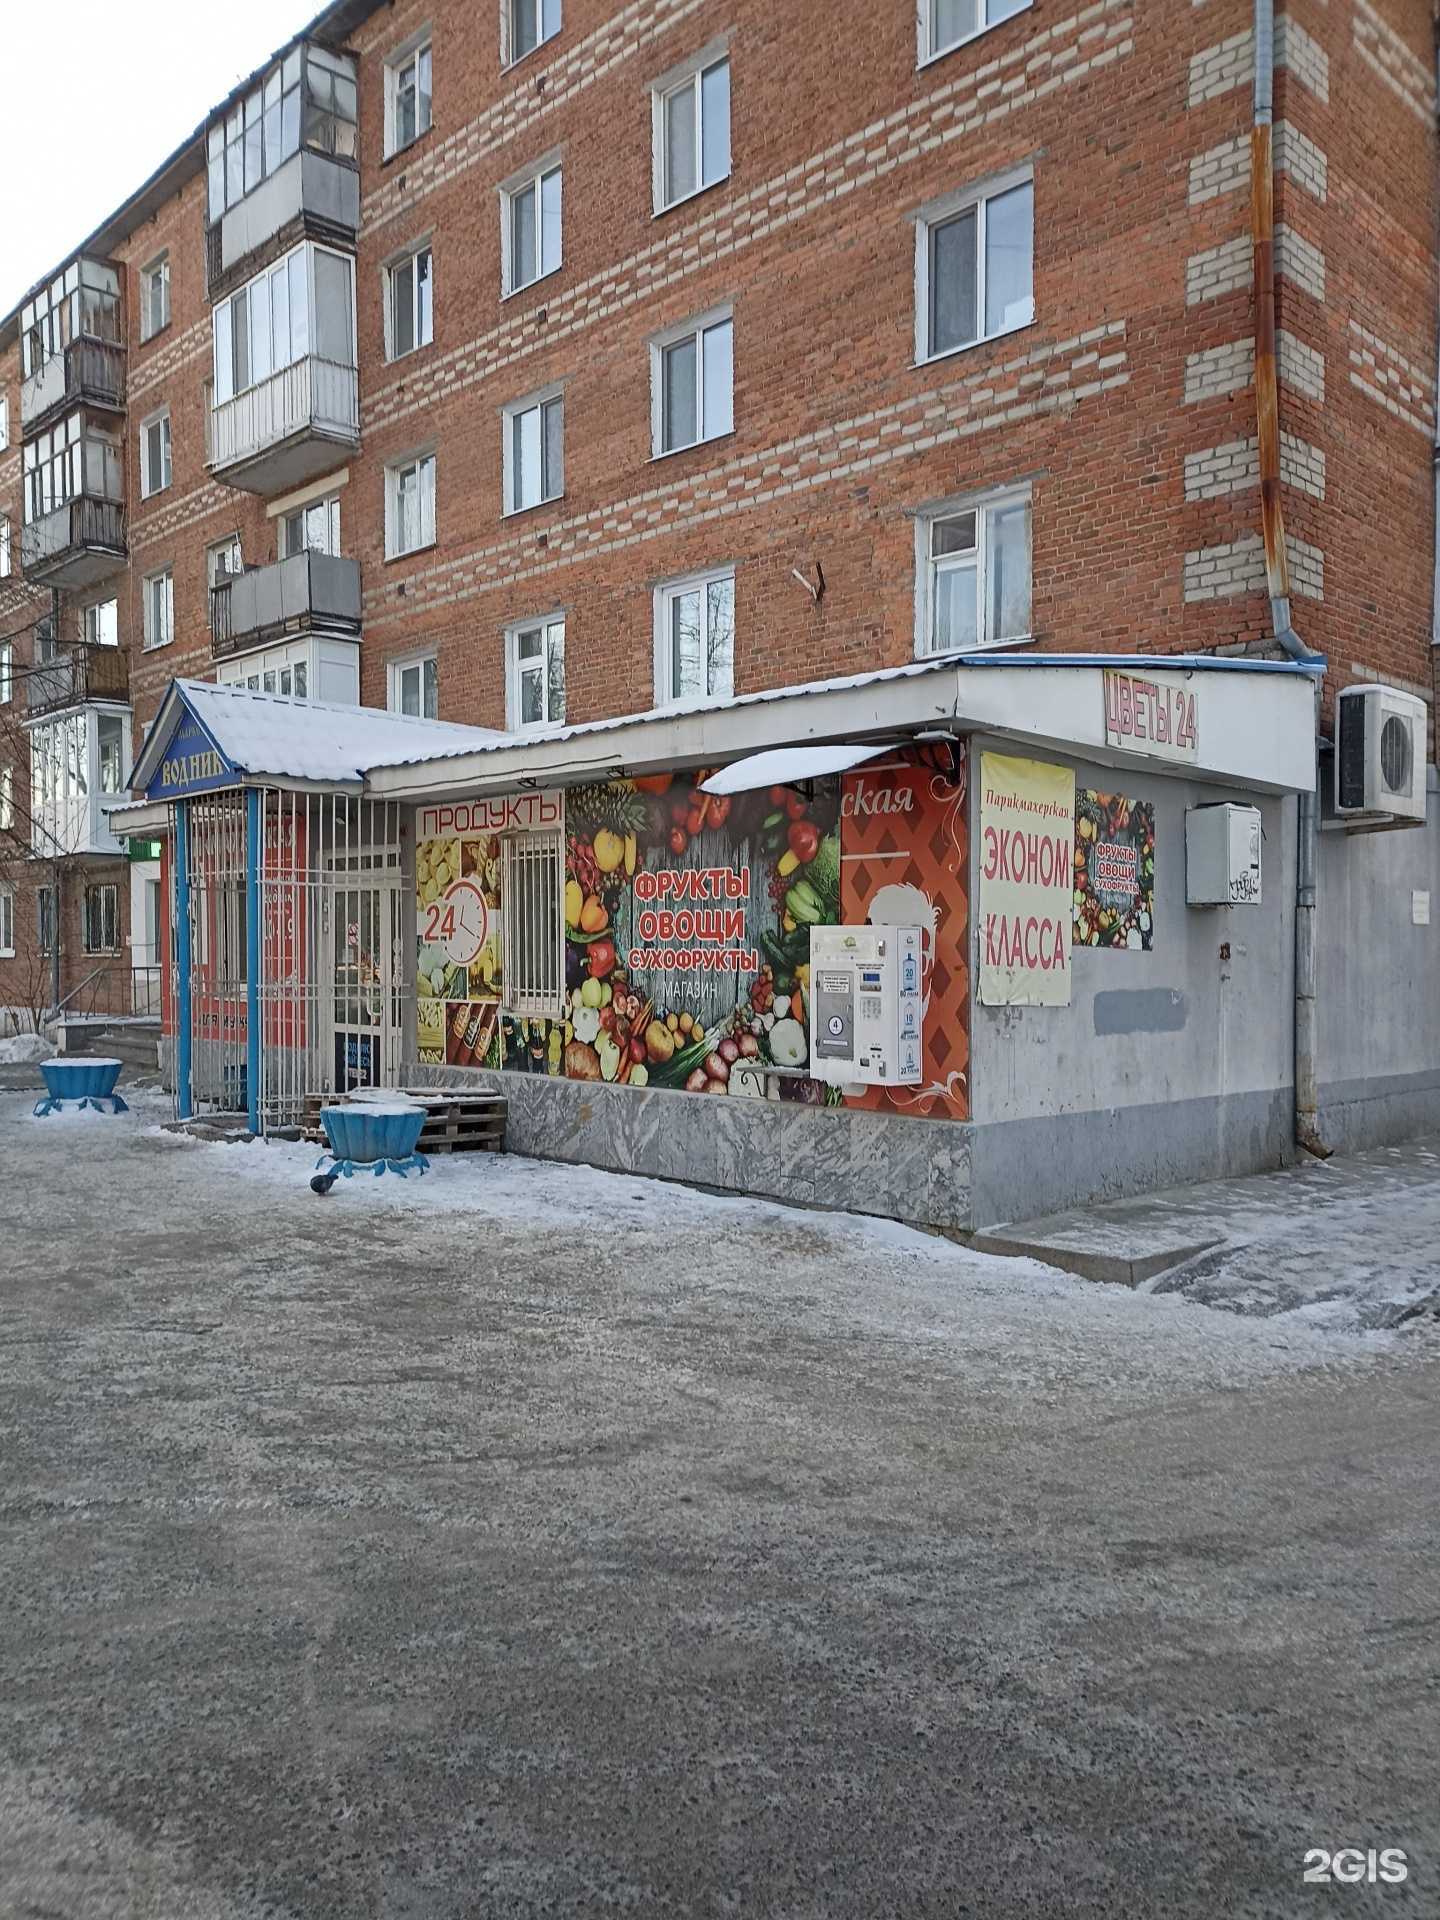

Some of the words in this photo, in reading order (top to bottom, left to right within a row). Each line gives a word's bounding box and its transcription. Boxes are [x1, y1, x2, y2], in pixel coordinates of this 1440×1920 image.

[1105, 671, 1172, 746] ЦВЕТЫ
[1175, 690, 1197, 750] 24
[161, 750, 224, 788] ВОДНИК
[423, 793, 562, 835] ПРОДУКТЫ
[986, 789, 1069, 819] Парикмахерская
[983, 825, 1070, 889] ЭКОНОМ
[1097, 842, 1137, 863] ФРУКТЫ
[635, 866, 750, 901] ФРУКТЫ
[1094, 878, 1140, 895] СУХОФРУКТЫ
[1098, 861, 1136, 882] ОВОЩИ
[424, 904, 457, 941] 24
[639, 908, 746, 947] ОВОЩИ
[985, 913, 1065, 970] КЛАССА
[628, 948, 759, 972] СУХОФРУКТЫ
[662, 981, 718, 999] МАГАЗИН
